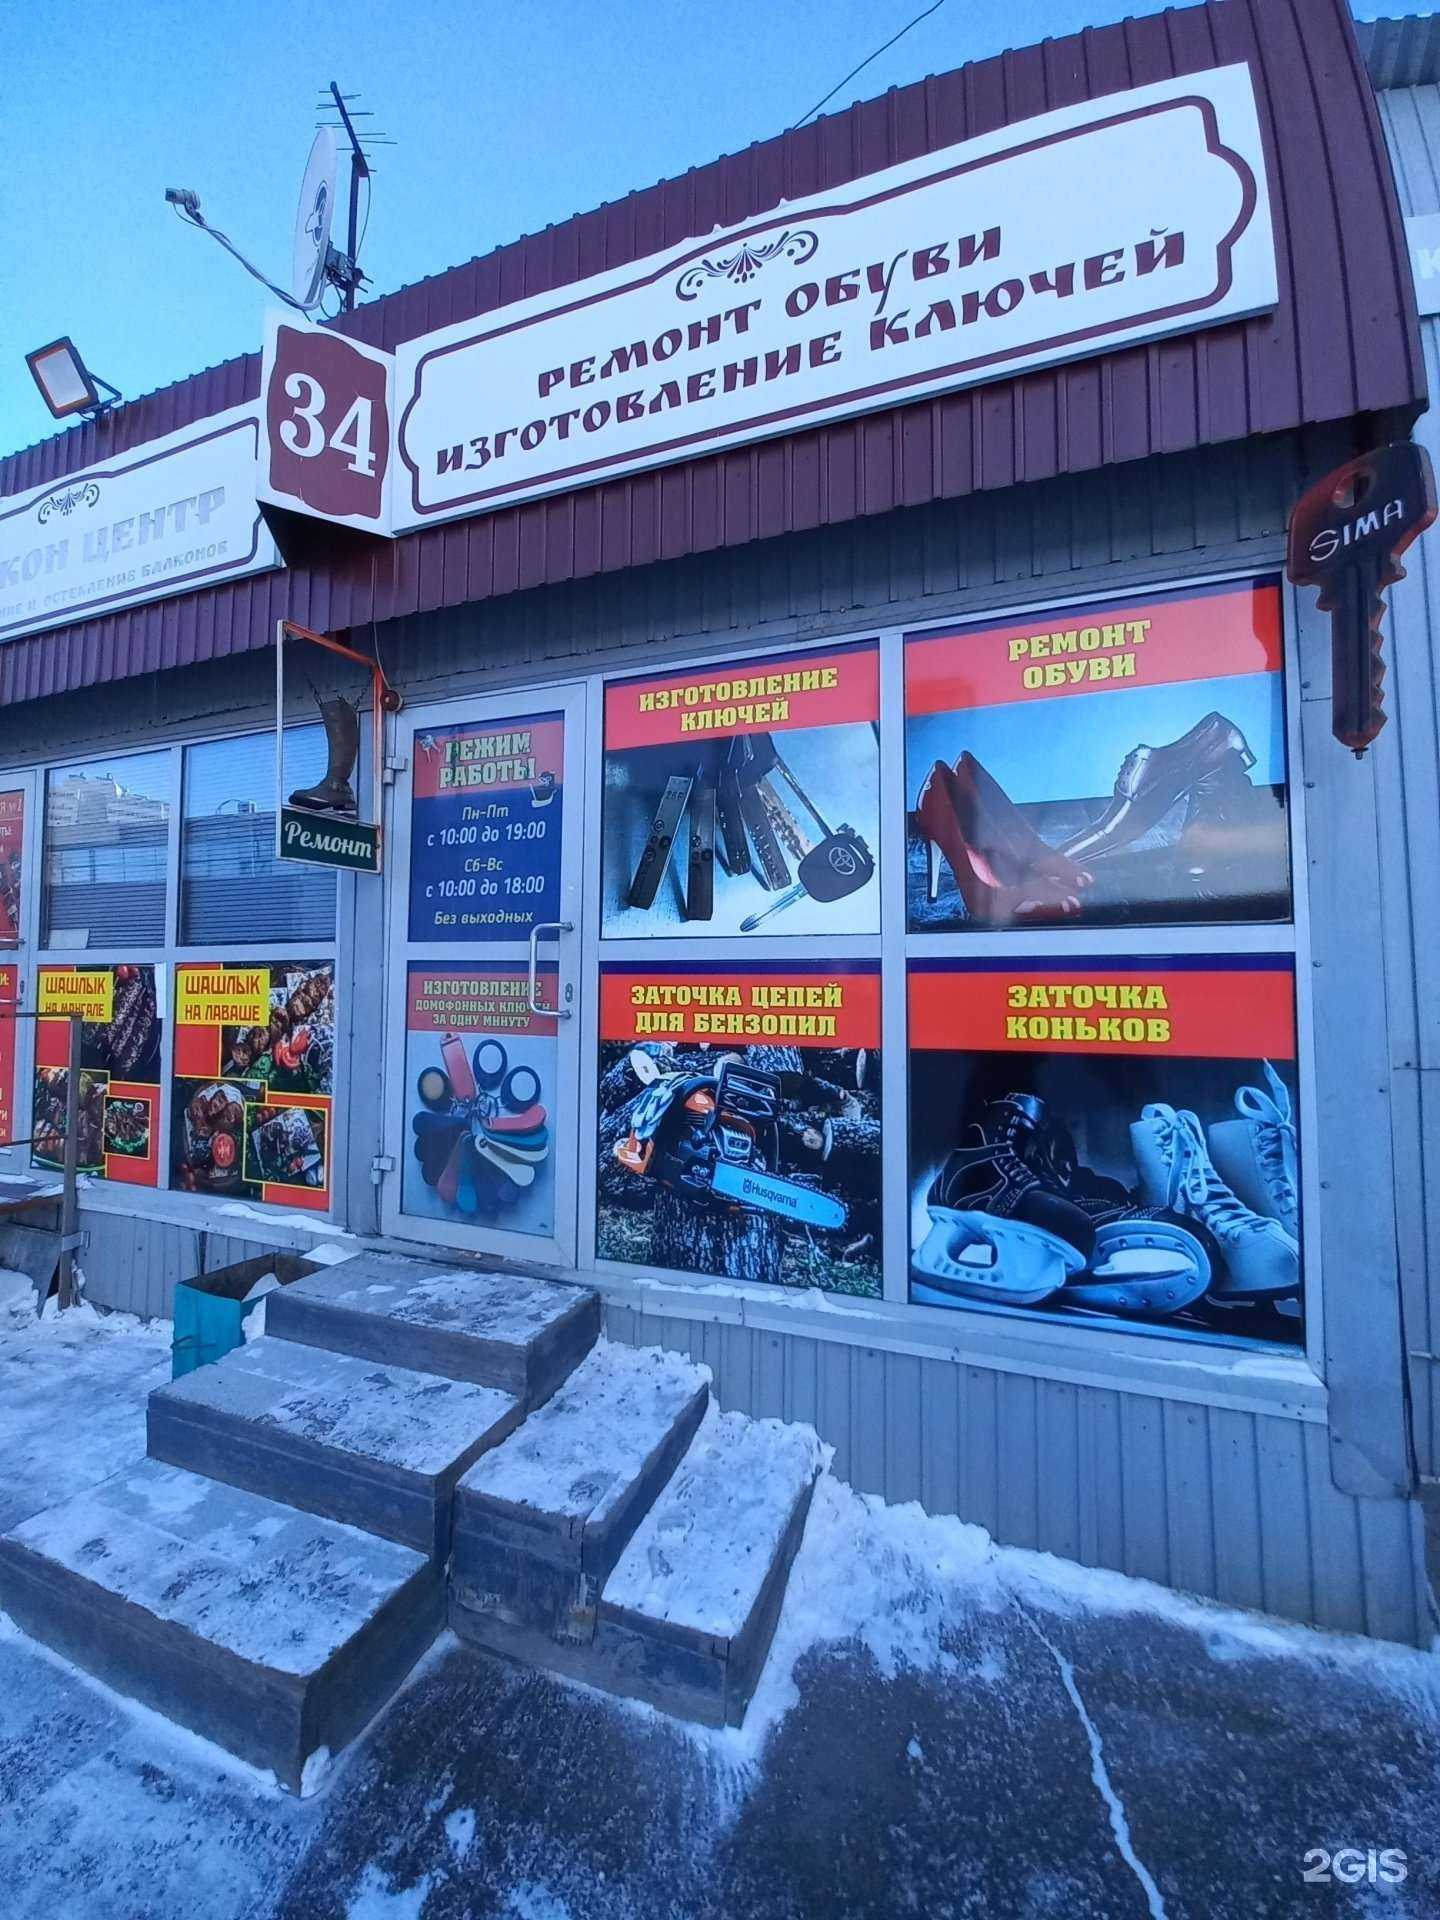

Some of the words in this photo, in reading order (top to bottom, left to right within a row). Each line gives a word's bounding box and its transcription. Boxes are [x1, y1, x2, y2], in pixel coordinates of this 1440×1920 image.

[538, 298, 762, 399] РЕМОНТ
[785, 226, 1001, 316] ОБУВИ
[437, 331, 842, 476] ИЗГОТОВЛЕНИЕ
[869, 228, 1185, 351] КЛЮЧЕЙ
[279, 372, 377, 478] 34
[83, 486, 225, 564] ЦЕНТР
[1309, 500, 1403, 561] SIMA
[1007, 619, 1152, 661] РЕМОНТ
[1022, 652, 1137, 689] ОБУВИ
[638, 666, 839, 713] ИЗГОТОВЛЕНИЕ
[680, 696, 790, 732] КЛЮЧЕЙ
[439, 757, 537, 789] РАБОТЫ
[462, 804, 509, 821] Пн-Пт
[284, 820, 372, 859] Ремонт
[427, 834, 435, 846] с
[440, 826, 478, 845] 10:00
[481, 826, 499, 842] до
[506, 820, 546, 841] 19:00
[464, 857, 504, 873] Сб-Вс
[426, 885, 433, 898] с
[438, 879, 476, 897] 10:00
[480, 878, 498, 895] до
[504, 875, 545, 894] 18:00
[434, 910, 457, 925] Без
[461, 909, 534, 924] выходных
[45, 977, 105, 995] ШАШЛЫК
[185, 975, 260, 995] ШАШЛЫК
[631, 984, 742, 1007] ЗАТОЧКА
[751, 982, 843, 1008] ЦЕПЕЙ
[1006, 984, 1168, 1010] ЗАТОЧКА
[185, 1004, 201, 1020] НА
[205, 1005, 260, 1021] ЛАВАШЕ
[415, 999, 496, 1012] ДОМОФОННЫХ
[432, 1014, 446, 1025] ЗА
[450, 1014, 479, 1026] ОДНУ
[483, 1015, 530, 1028] МИНУТУ
[635, 1012, 685, 1035] ДЛЯ
[693, 1012, 836, 1037] БЕНЗОПИЛ
[1006, 1016, 1171, 1043] КОНЬКОВ
[752, 1182, 797, 1209] Husqvarna
